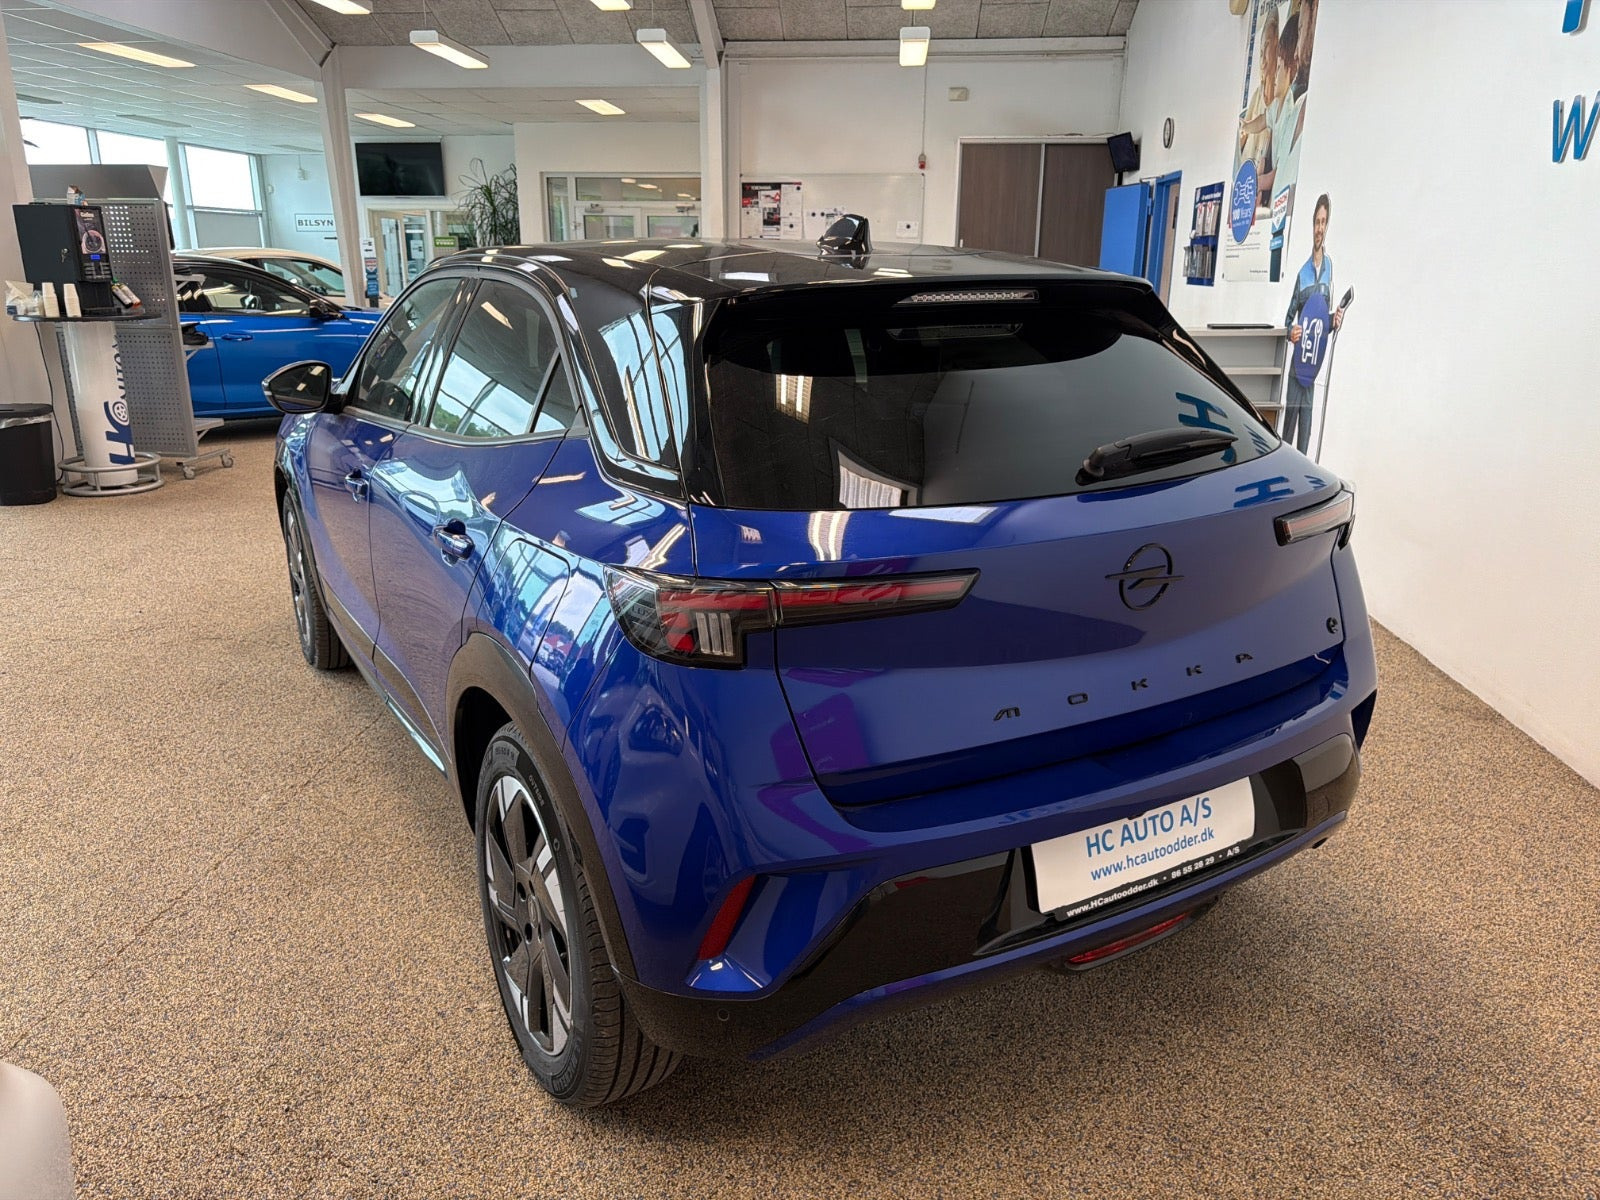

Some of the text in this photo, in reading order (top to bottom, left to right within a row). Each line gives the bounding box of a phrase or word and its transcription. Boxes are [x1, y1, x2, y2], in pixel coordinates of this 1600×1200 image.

[297, 219, 334, 227] BILSYN
[993, 653, 1253, 721] MOKKA
[1086, 797, 1212, 858] HC AUTO A/S
[1090, 827, 1215, 881] www.hcautoodder.dk
[1066, 846, 1241, 917] www.HCautoodder.dk 86 55 28 29 A/S
